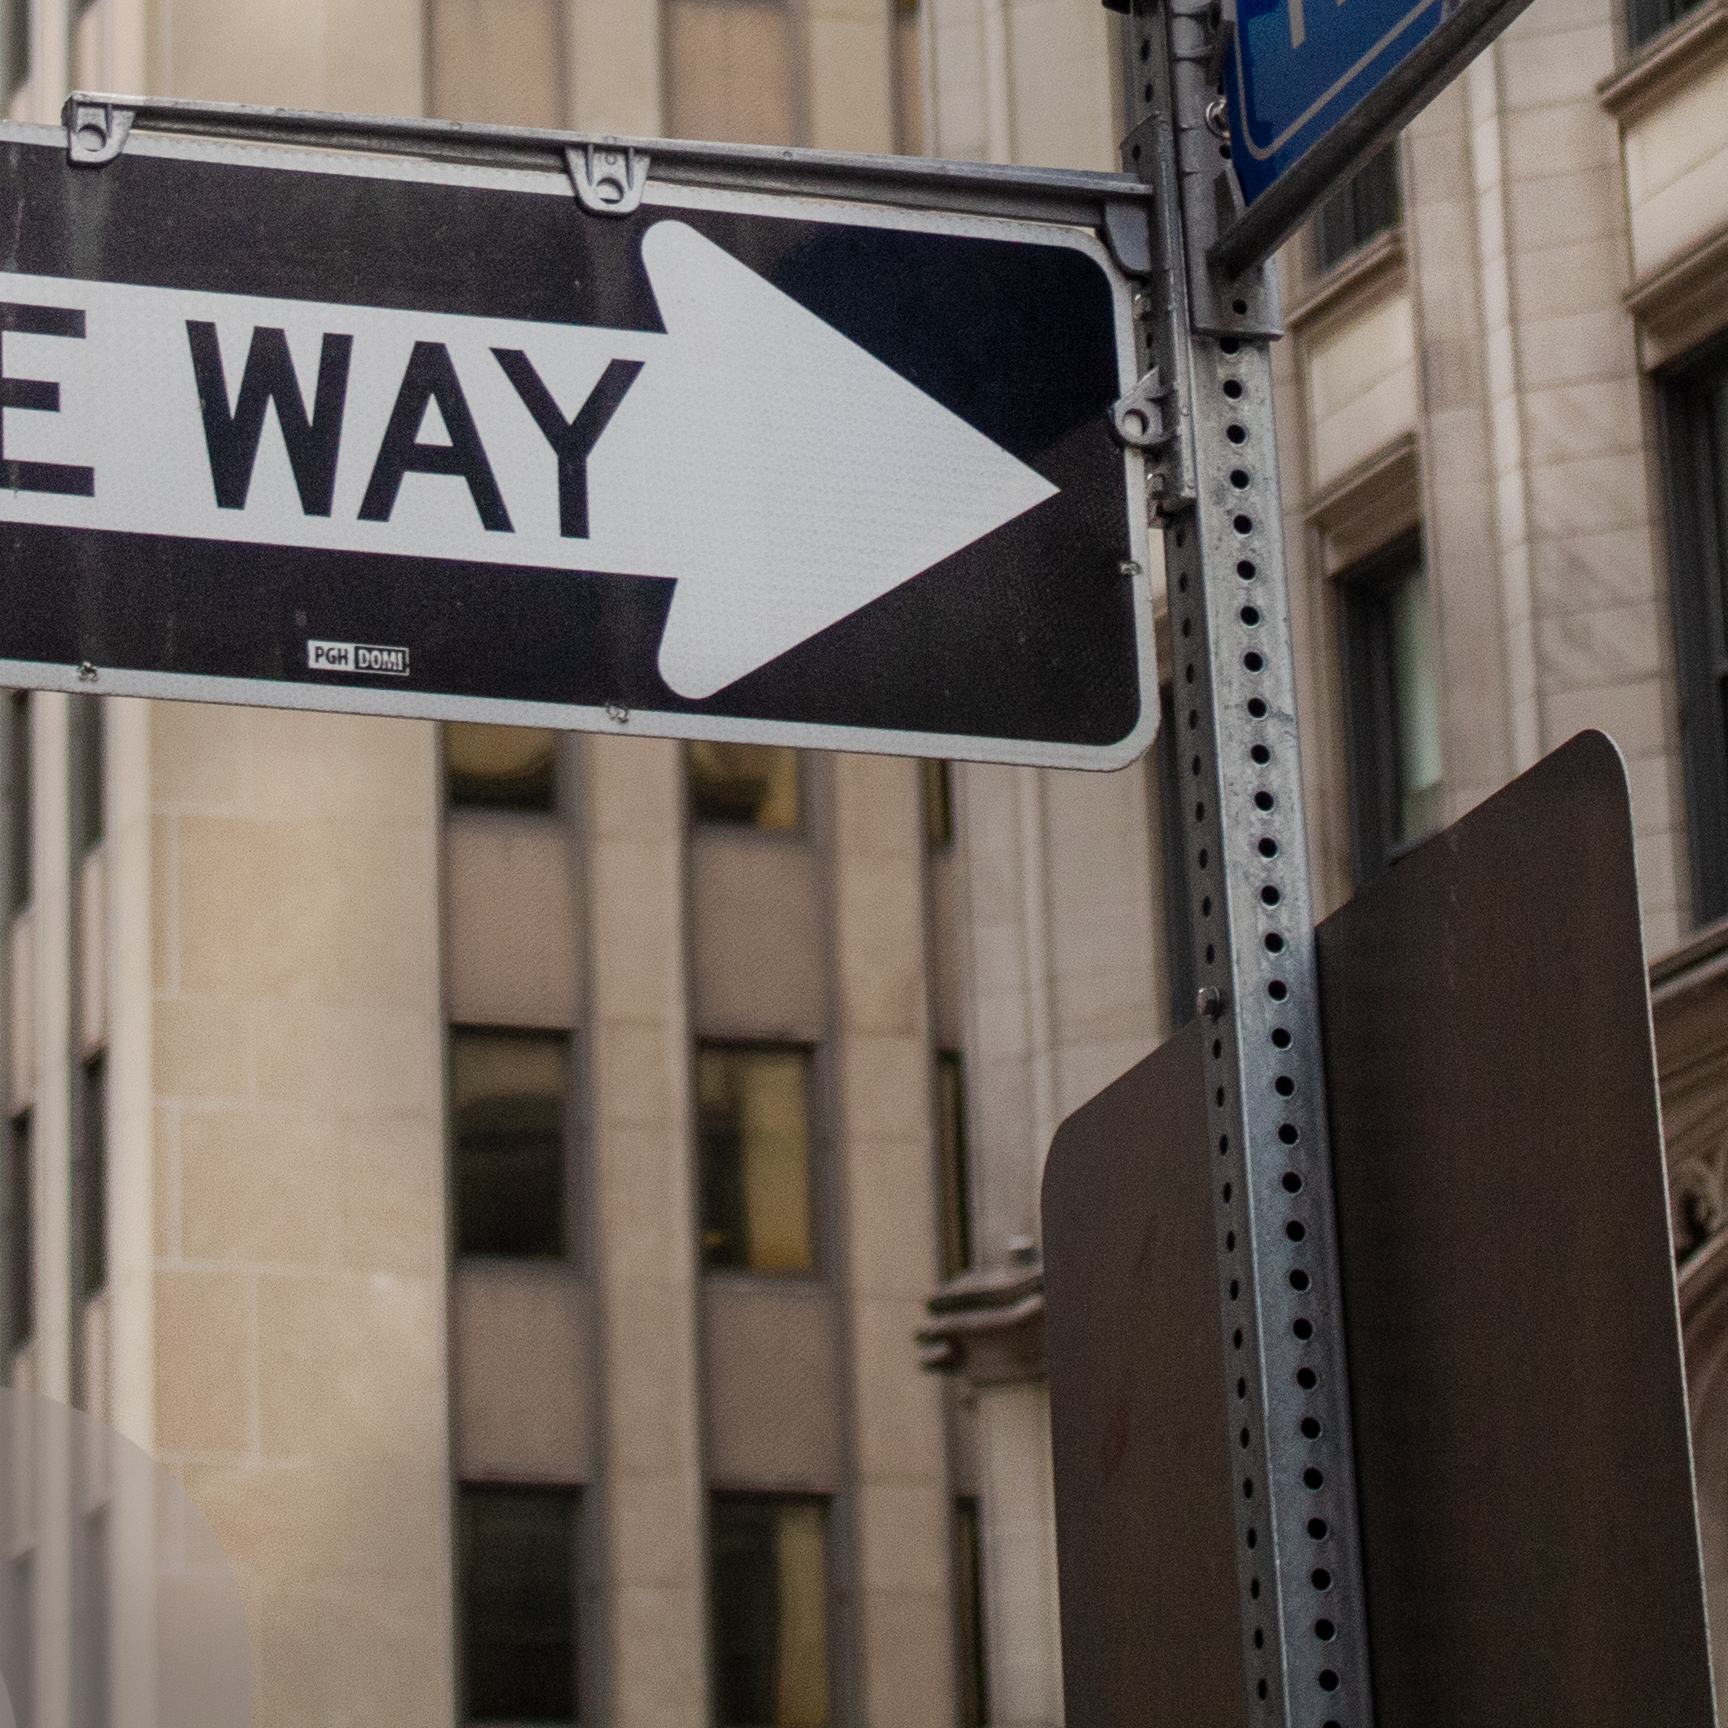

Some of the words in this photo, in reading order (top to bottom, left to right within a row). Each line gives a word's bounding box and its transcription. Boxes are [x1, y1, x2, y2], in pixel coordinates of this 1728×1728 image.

[185, 320, 644, 539] WAY
[314, 646, 349, 666] PGH
[357, 648, 404, 671] DOMI
